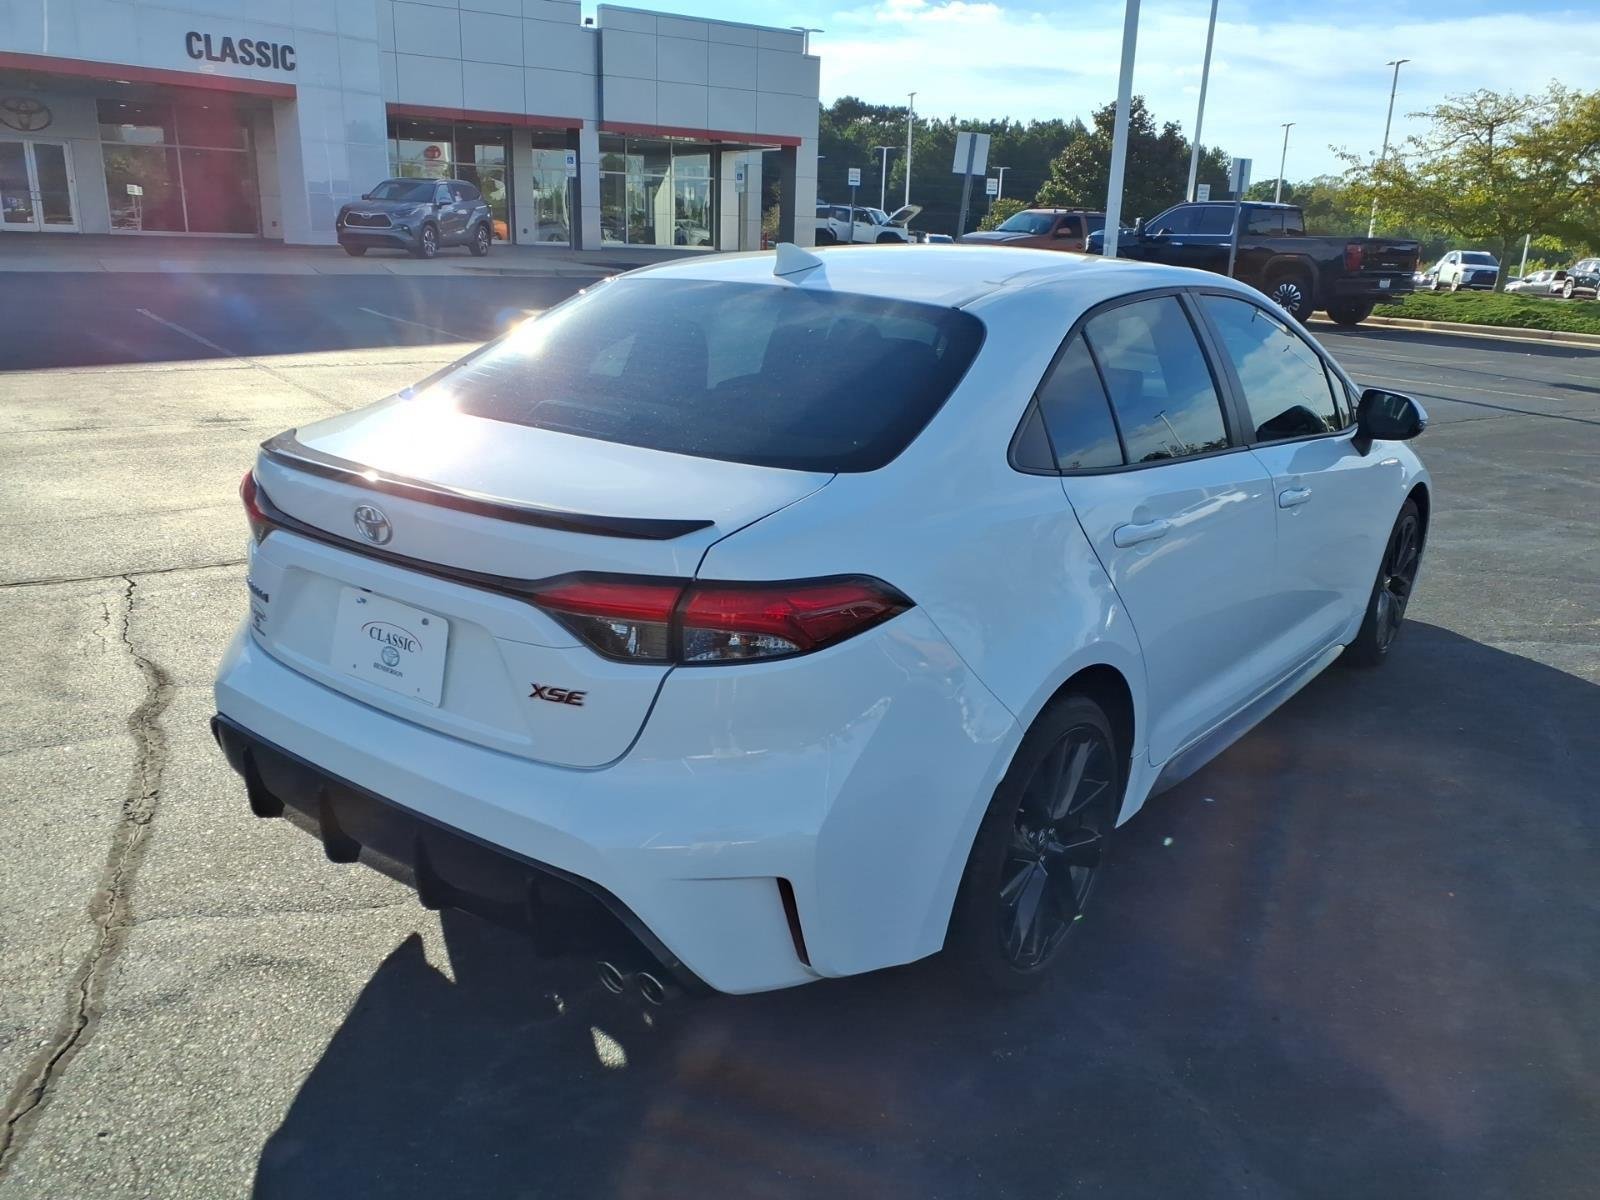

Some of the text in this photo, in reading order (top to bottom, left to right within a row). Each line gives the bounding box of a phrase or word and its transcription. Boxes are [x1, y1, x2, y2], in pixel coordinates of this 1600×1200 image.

[185, 31, 296, 71] CLASSIC
[369, 626, 416, 653] CLASSIC
[528, 682, 588, 706] XSE
